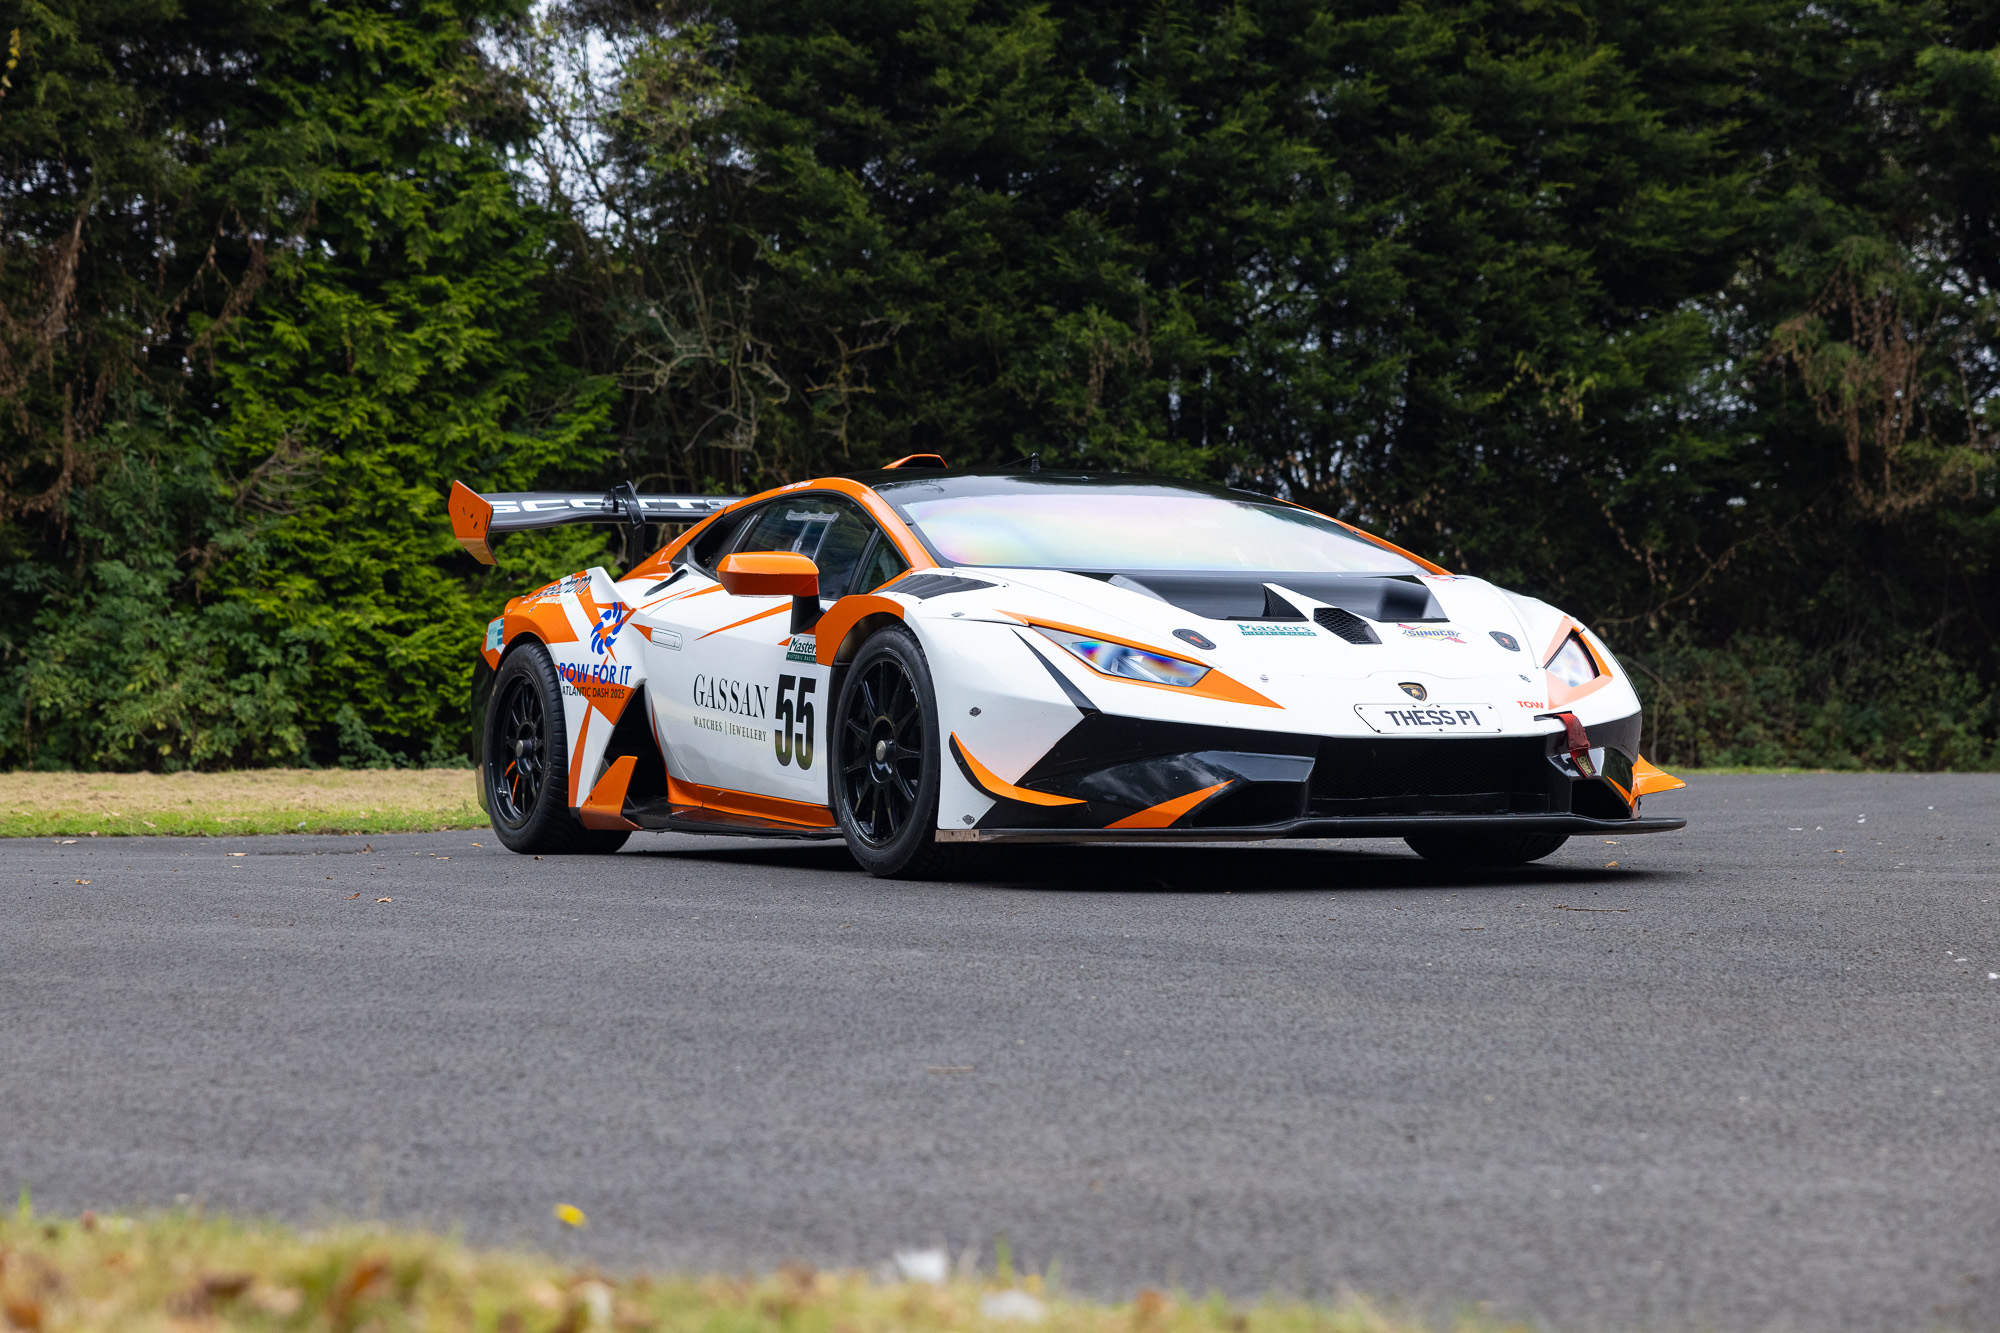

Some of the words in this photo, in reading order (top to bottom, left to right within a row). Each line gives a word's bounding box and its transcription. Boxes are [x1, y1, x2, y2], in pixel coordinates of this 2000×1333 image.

[1237, 624, 1311, 632] Masters
[789, 637, 817, 655] Master
[559, 662, 590, 683] ROW
[592, 664, 617, 685] FOR
[620, 665, 632, 685] IT
[561, 685, 591, 698] ATLANTIC
[592, 687, 610, 699] DASH
[611, 688, 625, 699] 2025
[693, 673, 770, 720] GASSAN
[1516, 700, 1544, 709] TOW
[693, 716, 723, 733] WATCHES
[729, 722, 767, 742] JEWELLERY
[774, 673, 817, 771] 55
